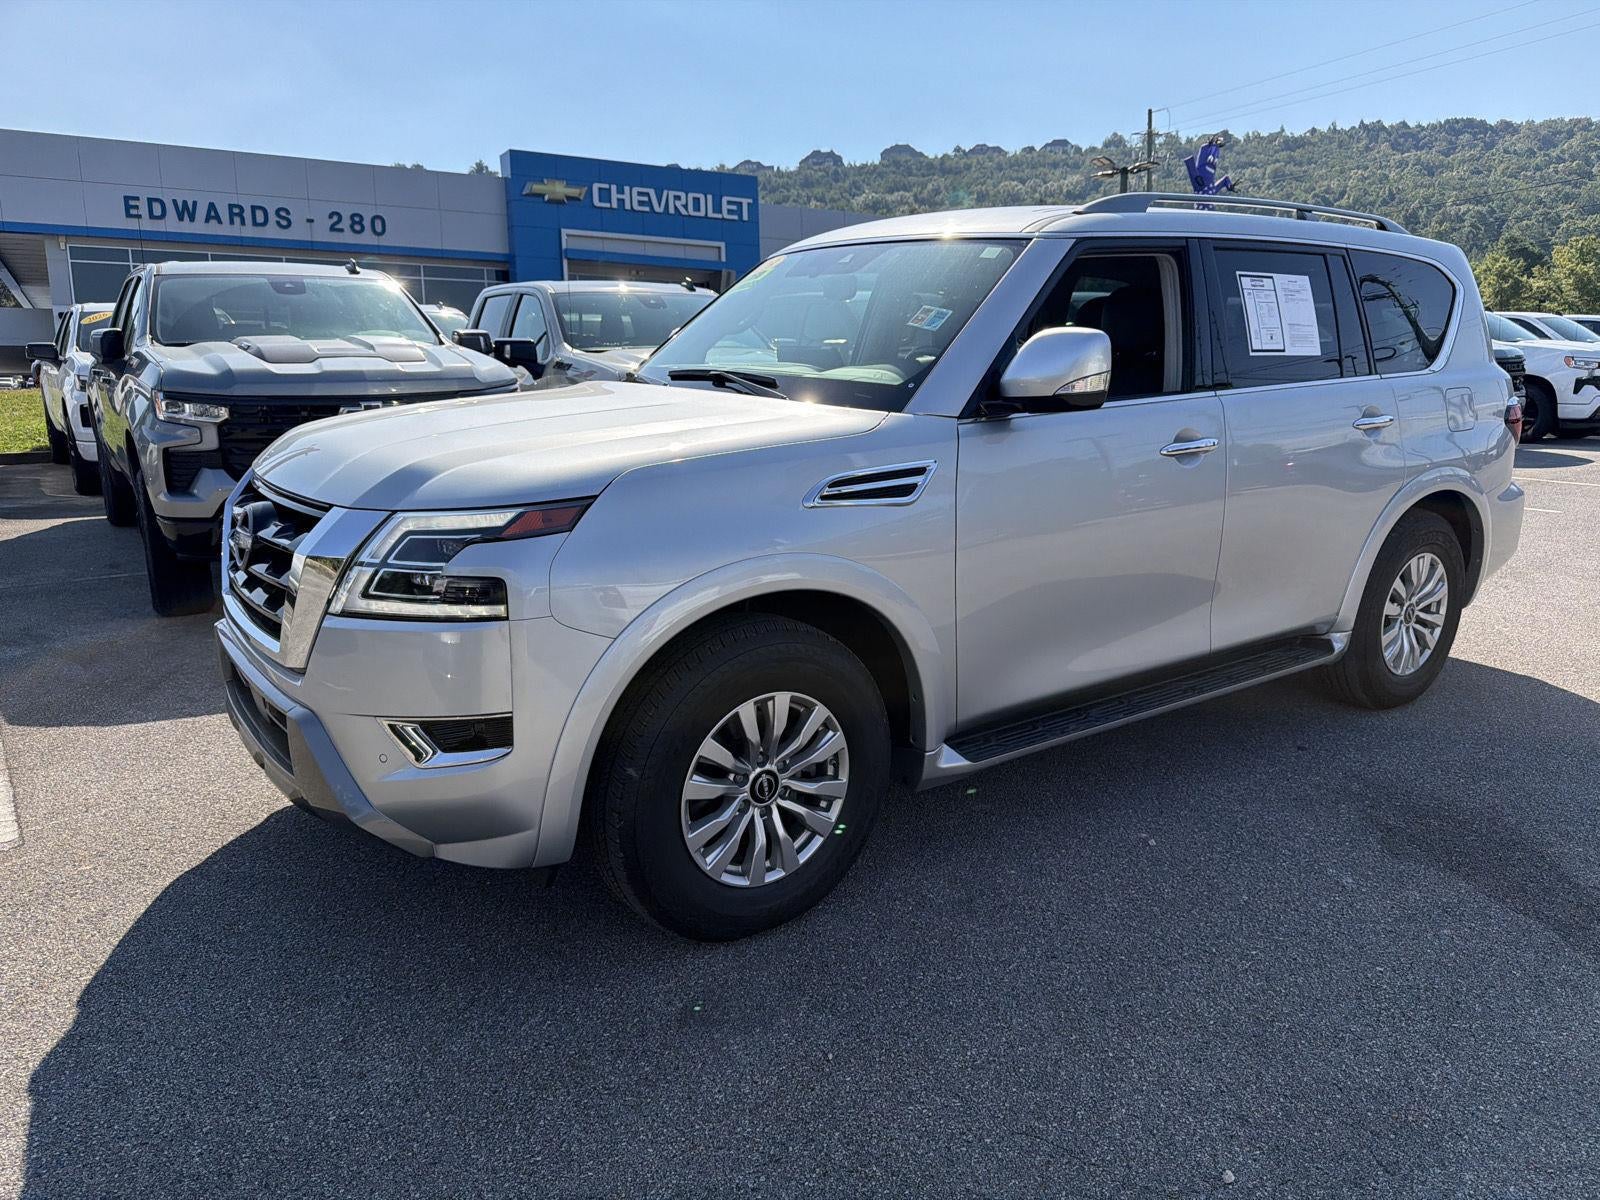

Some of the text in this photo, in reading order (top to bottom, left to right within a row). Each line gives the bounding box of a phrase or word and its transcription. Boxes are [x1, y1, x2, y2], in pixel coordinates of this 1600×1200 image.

[123, 195, 292, 230] EDWARDS
[328, 211, 387, 237] 280
[592, 182, 753, 221] CHEVROLET
